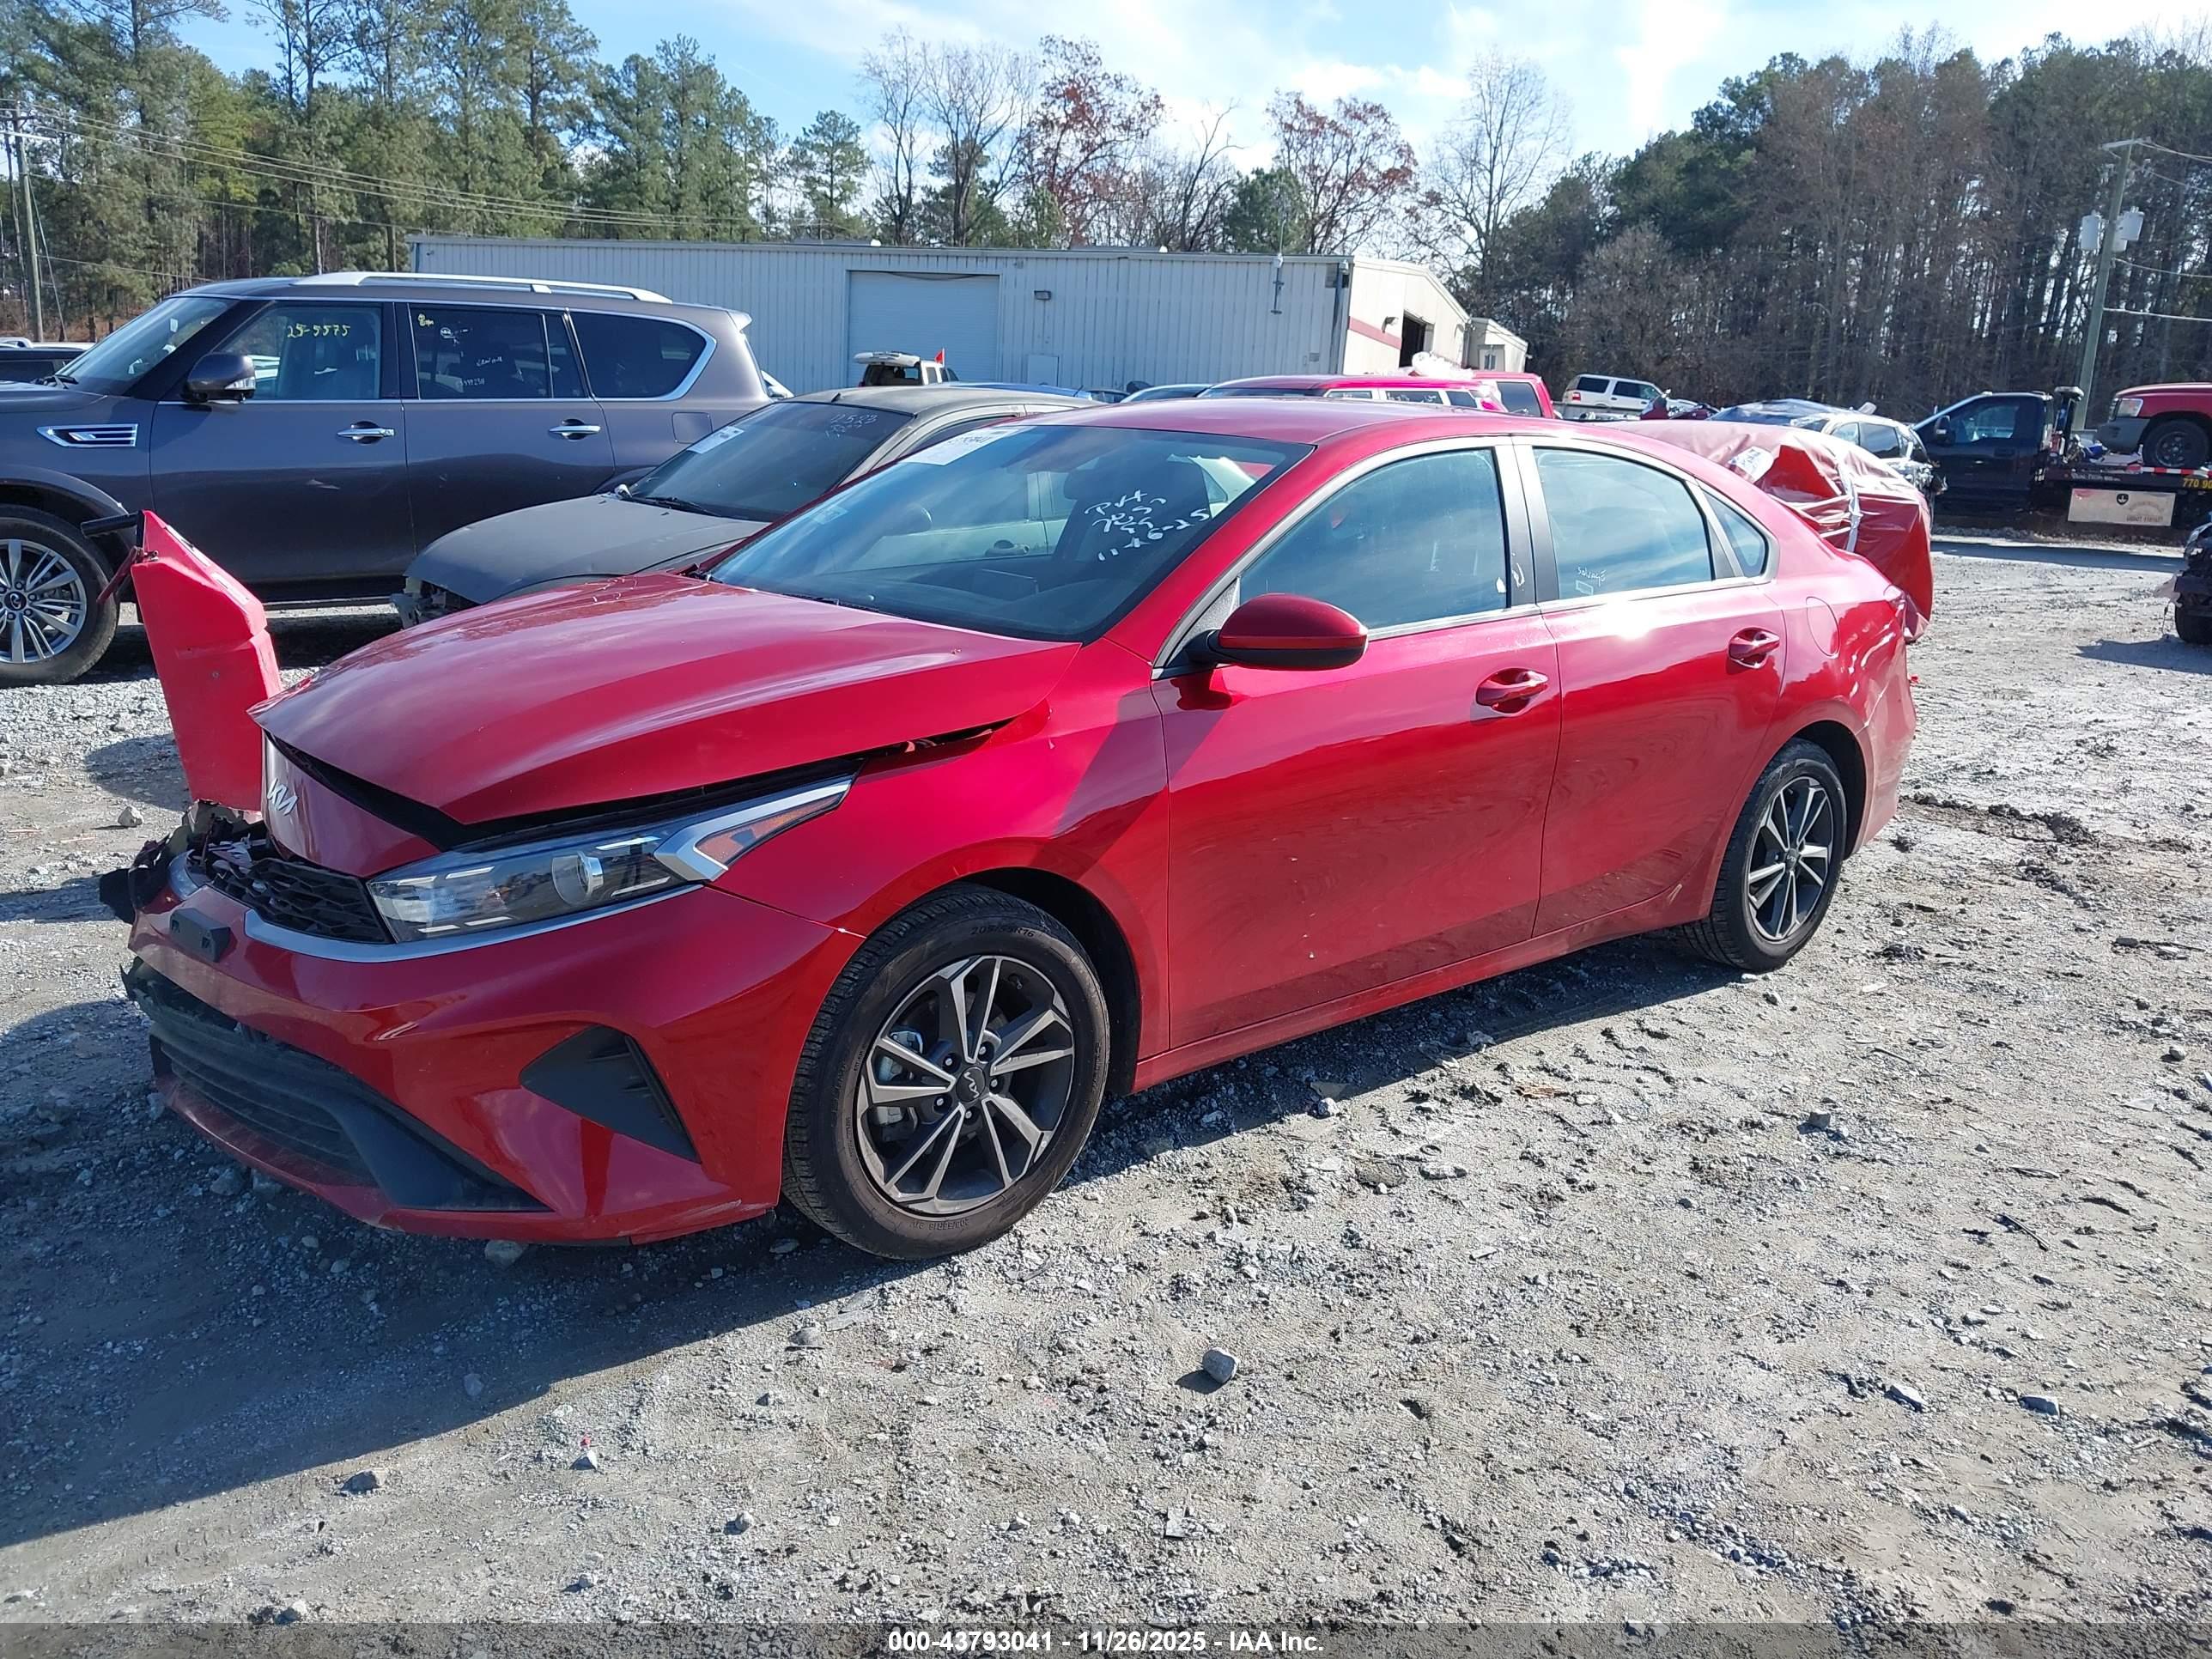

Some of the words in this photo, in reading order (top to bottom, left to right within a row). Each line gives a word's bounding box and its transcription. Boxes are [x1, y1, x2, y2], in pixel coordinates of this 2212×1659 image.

[287, 322, 350, 338] 25-5575
[2183, 478, 2199, 488] 770
[266, 777, 299, 817] KIA
